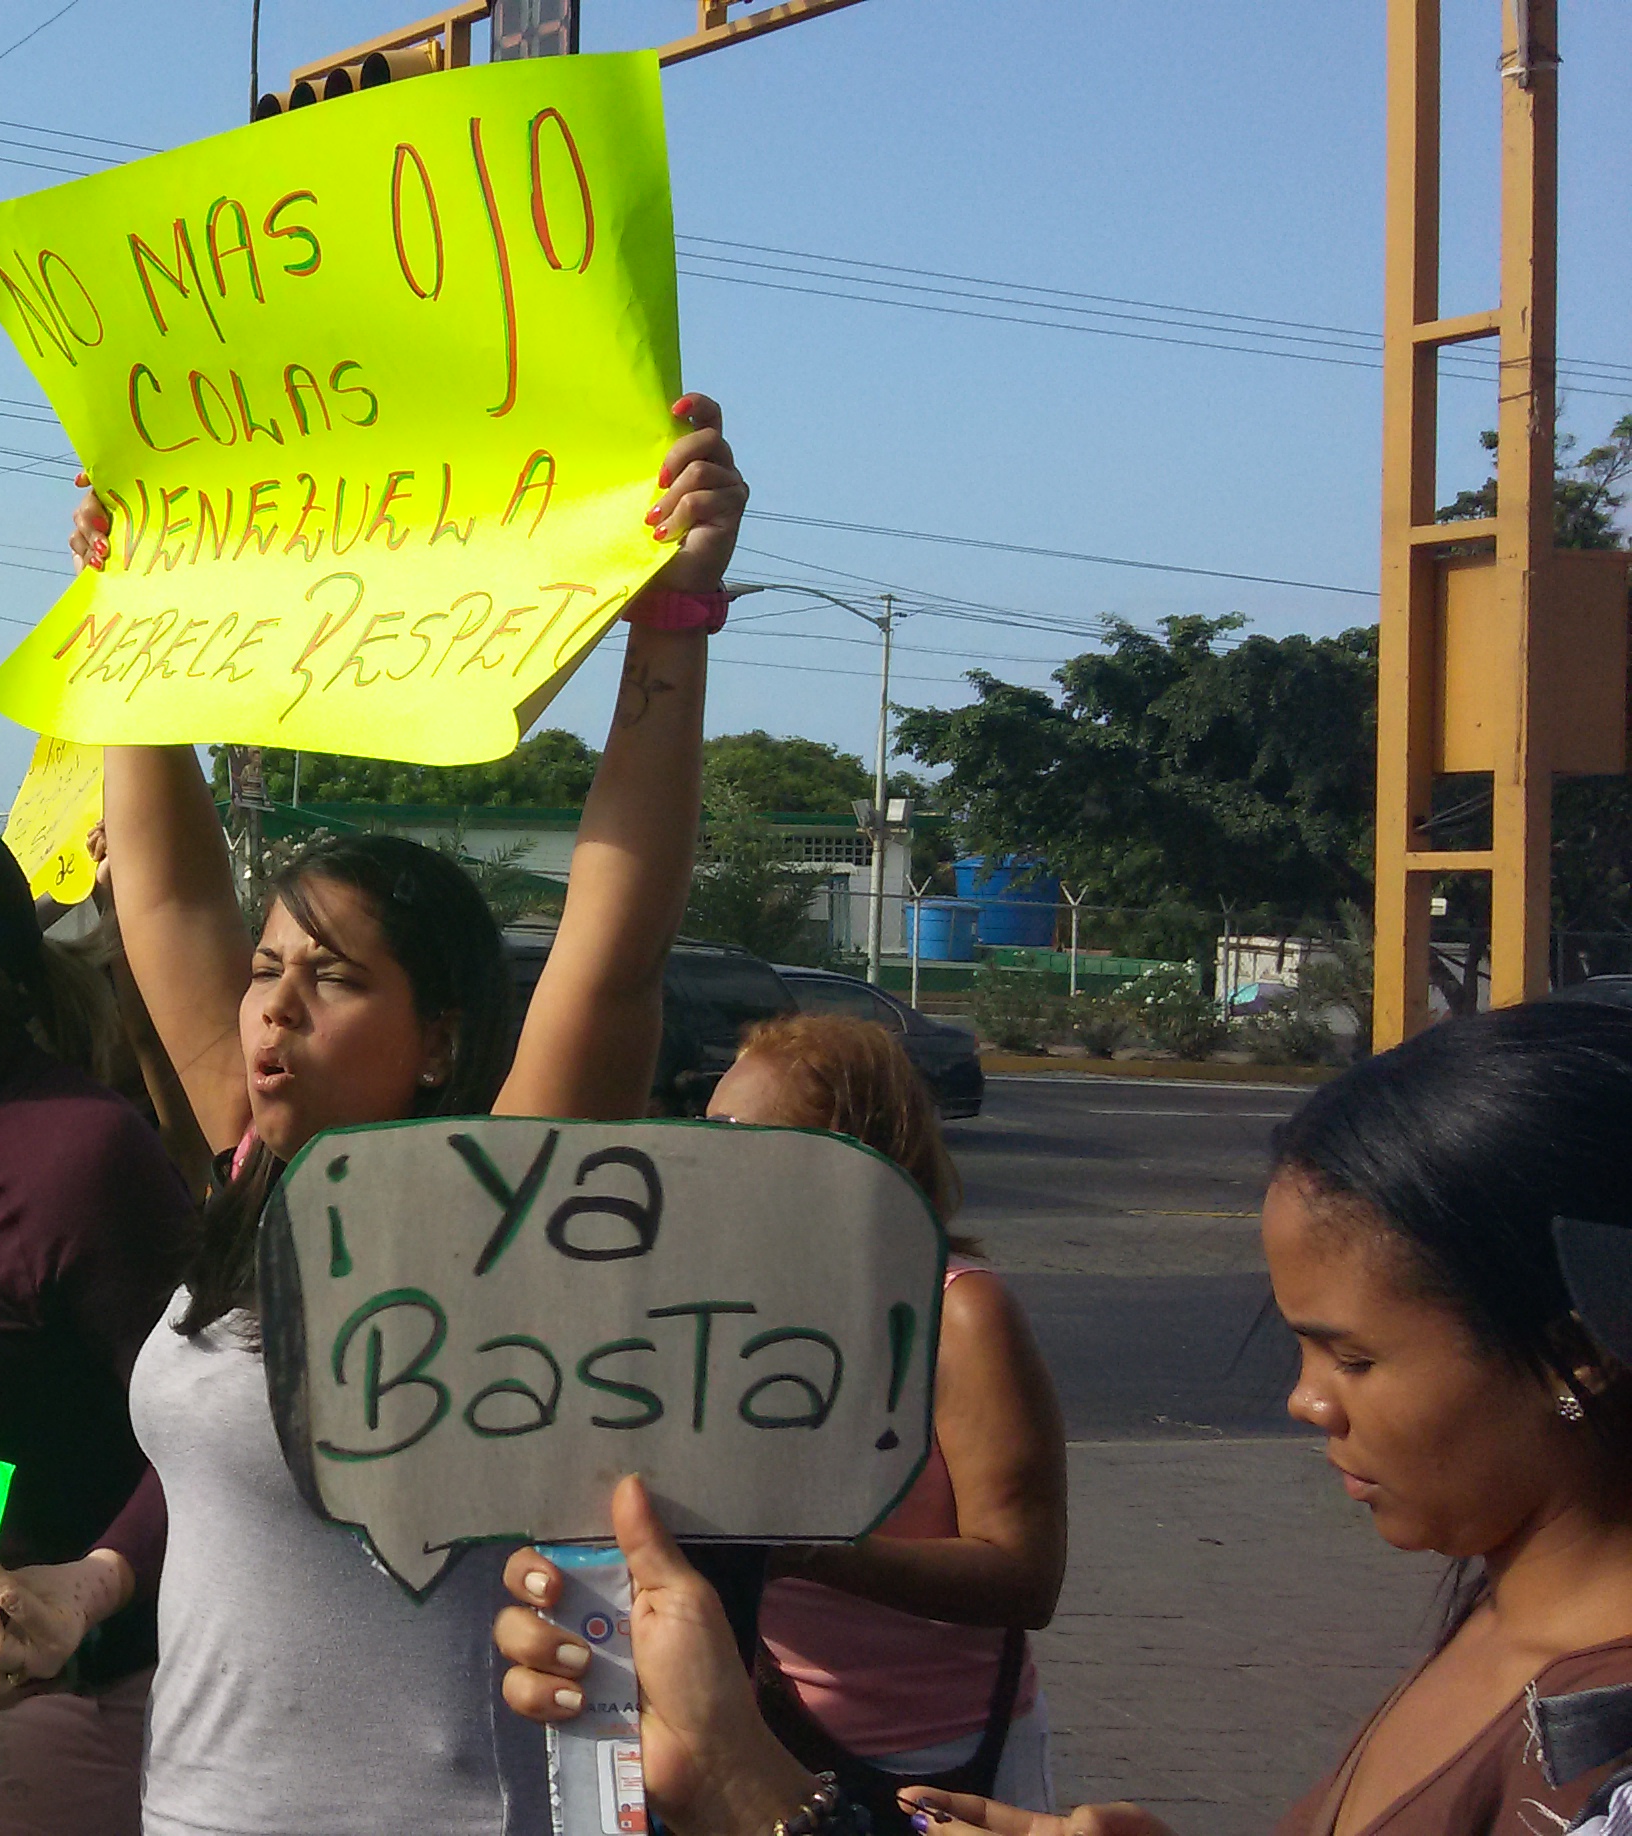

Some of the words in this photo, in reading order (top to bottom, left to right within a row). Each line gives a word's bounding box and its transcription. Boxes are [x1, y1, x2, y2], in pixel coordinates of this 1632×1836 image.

[126, 189, 322, 343] MAS
[391, 106, 595, 418] OJO
[128, 359, 379, 453] COLAS
[53, 608, 282, 702] MERECE
[588, 1702, 619, 1713] ARA
